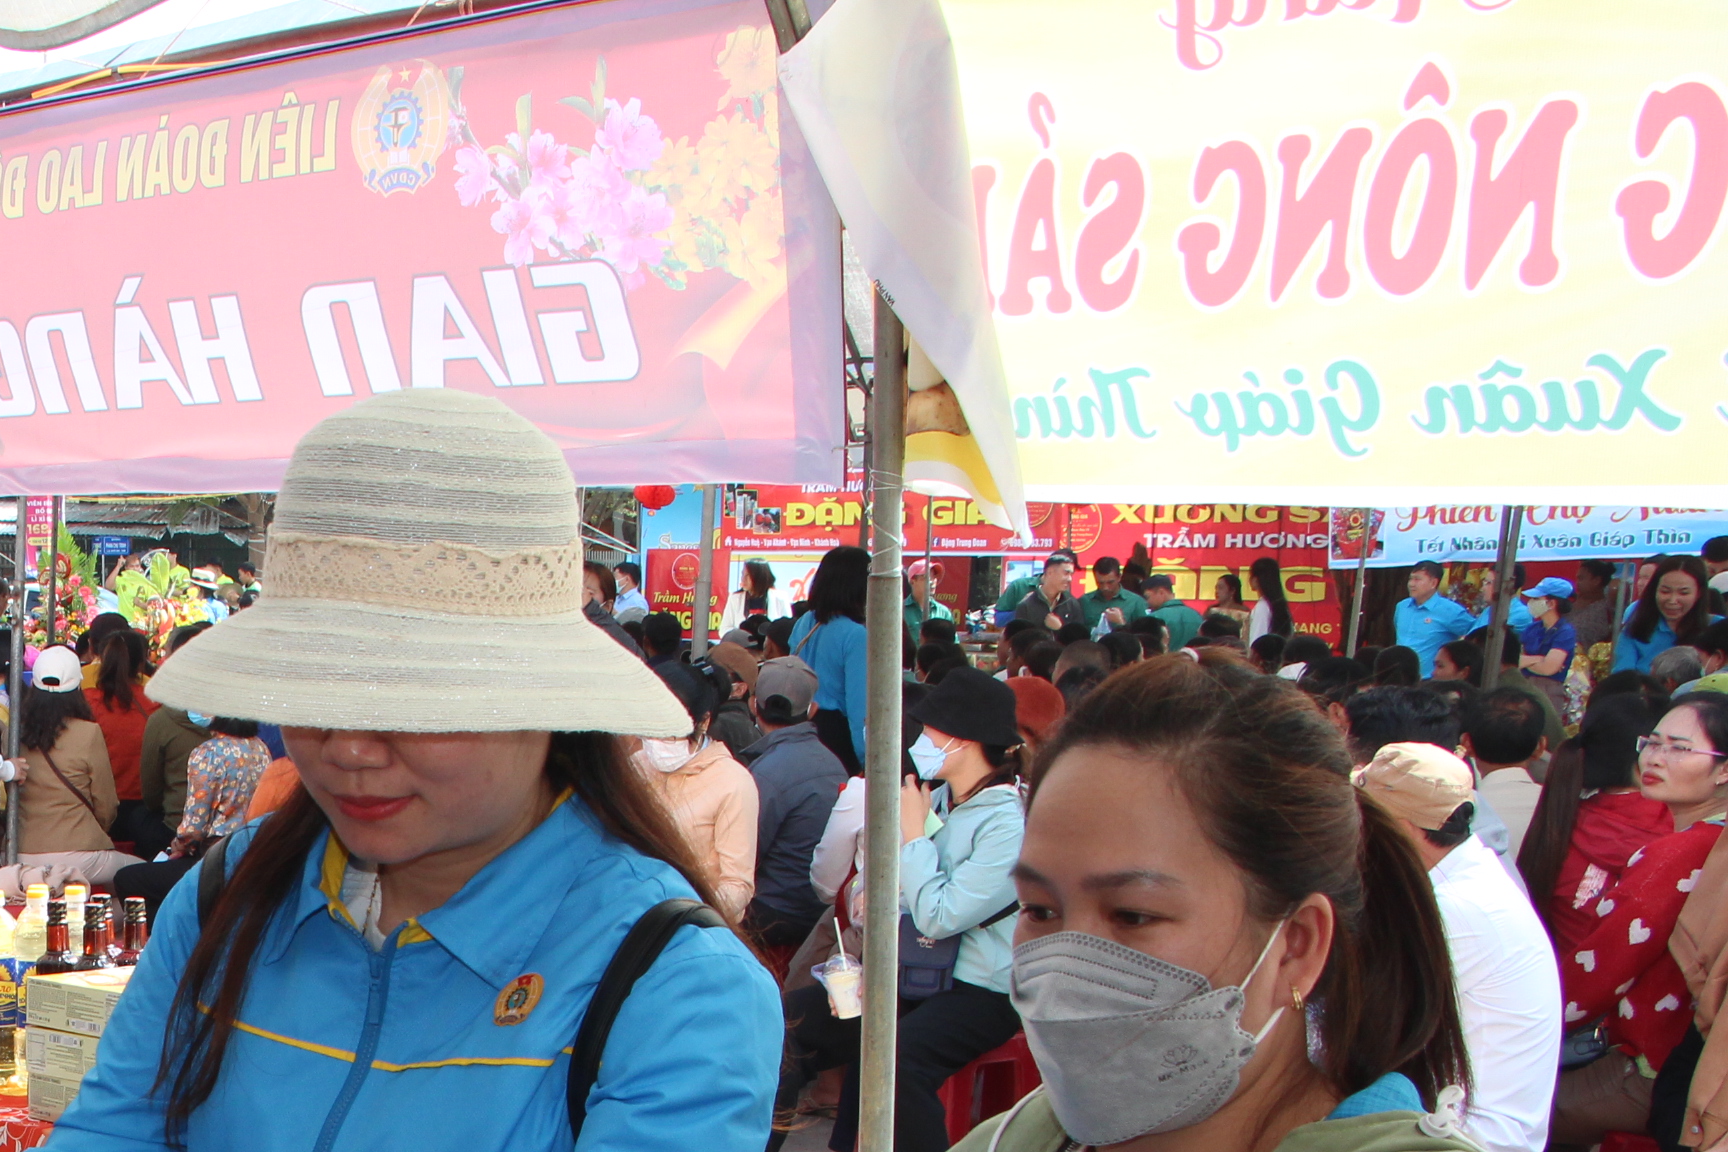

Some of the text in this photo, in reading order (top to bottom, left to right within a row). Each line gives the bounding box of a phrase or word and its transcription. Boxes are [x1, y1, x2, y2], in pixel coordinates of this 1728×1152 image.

[1224, 532, 1329, 549] HƯƠNG
[1415, 535, 1445, 554] Tết
[1531, 532, 1583, 549] Xuân
[1589, 530, 1635, 549] Giáp
[1642, 528, 1692, 545] Thìn
